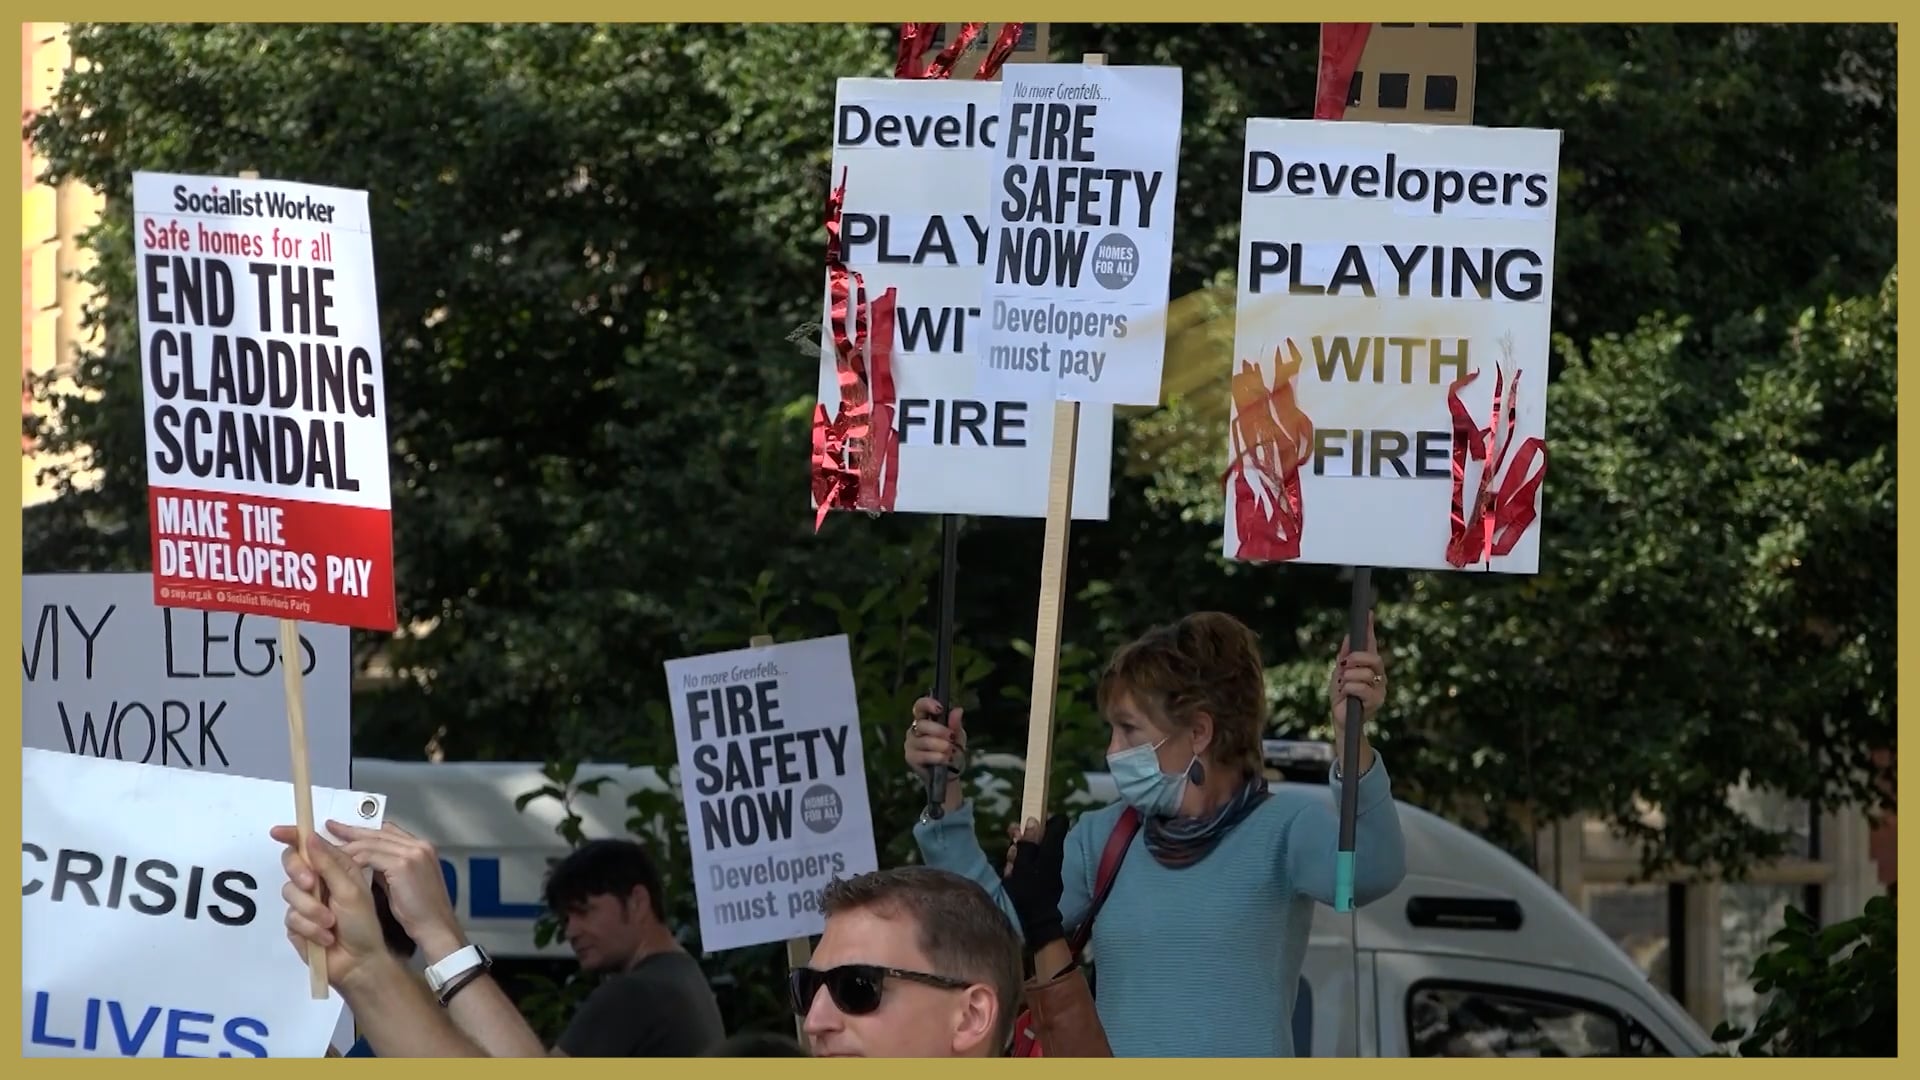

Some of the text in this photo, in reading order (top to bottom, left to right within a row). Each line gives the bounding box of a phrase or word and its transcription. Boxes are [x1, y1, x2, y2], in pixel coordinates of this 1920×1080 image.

[1013, 81, 1027, 98] No
[1028, 87, 1055, 99] more
[1006, 102, 1097, 162] FIRE
[173, 185, 334, 223] Socialist Worker
[1001, 164, 1162, 229] SAFETY
[1247, 150, 1548, 214] Developers
[144, 218, 332, 262] Safe homes for all
[995, 226, 1089, 288] NOW
[1098, 245, 1134, 260] HOMES
[1095, 260, 1135, 276] FOR ALL
[1249, 241, 1544, 301] PLAYING
[145, 254, 339, 338] END THE
[992, 299, 1128, 340] Developers
[149, 329, 376, 418] CLADDING
[989, 341, 1106, 383] must pay
[1311, 335, 1470, 385] WITH
[898, 398, 1028, 448] FIRE
[153, 405, 360, 492] SCANDAL
[1313, 429, 1452, 478] FIRE
[157, 497, 285, 546] MAKE THE
[159, 540, 372, 598] DEVELOPERS PAY
[171, 589, 311, 614] swp.org.uk Socialist Workers Party
[682, 673, 698, 689] No
[700, 671, 728, 686] more
[57, 700, 230, 768] WORK
[686, 680, 784, 741] FIRE
[693, 725, 849, 796] SAFETY
[700, 788, 793, 851] NOW
[804, 809, 822, 822] FOR
[823, 805, 840, 819] ALL
[709, 852, 845, 892] Developers
[713, 891, 779, 925] must
[31, 991, 269, 1058] LIVES
